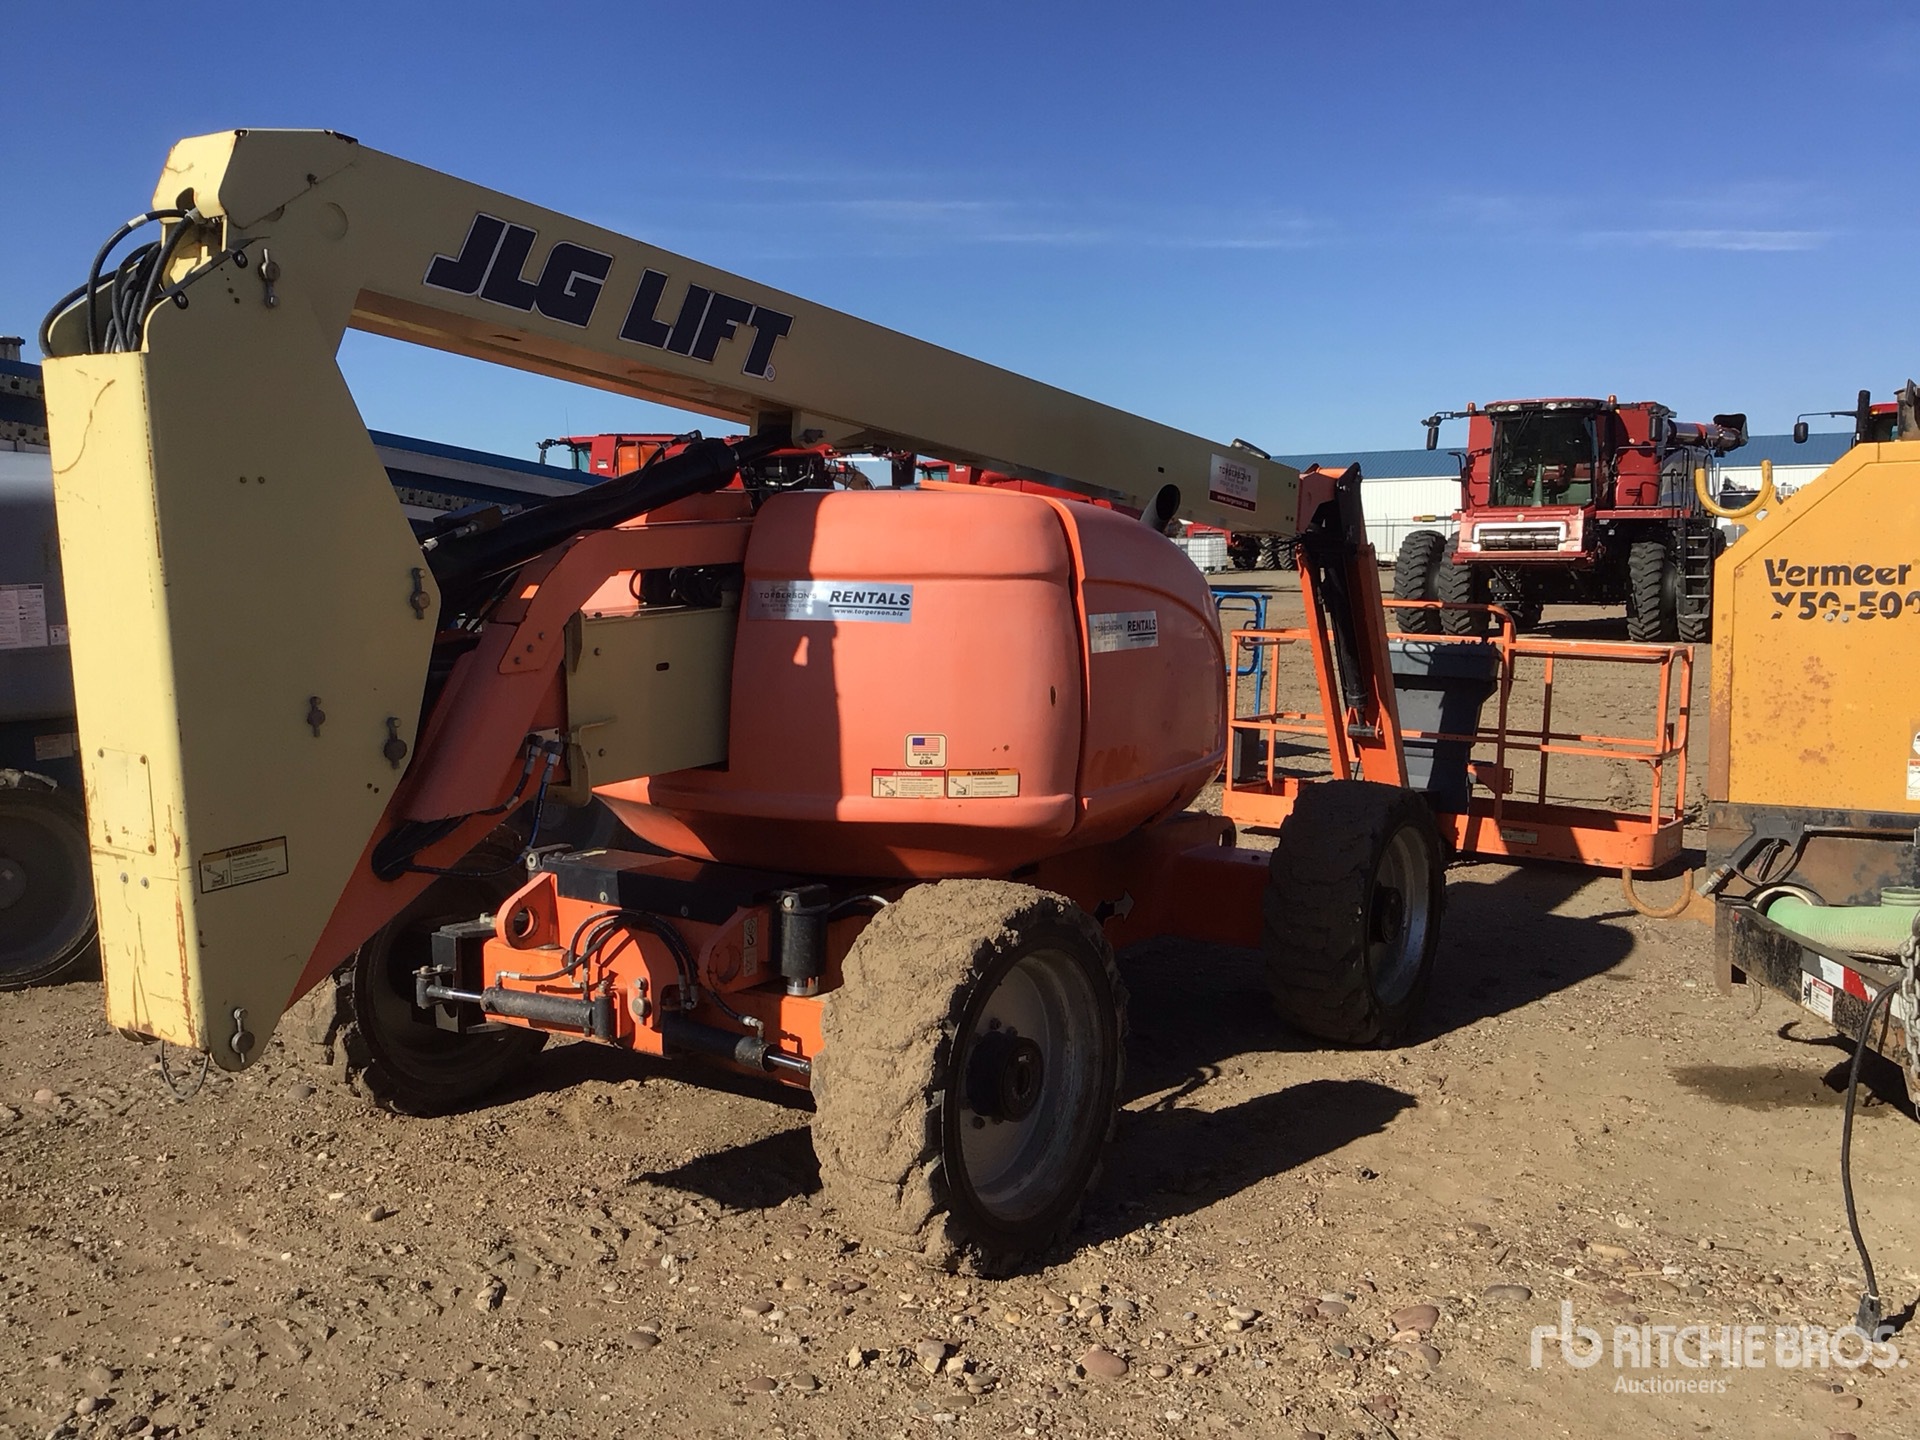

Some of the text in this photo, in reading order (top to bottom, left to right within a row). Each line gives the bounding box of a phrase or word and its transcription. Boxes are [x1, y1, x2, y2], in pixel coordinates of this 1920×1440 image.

[422, 211, 795, 379] JLG LIFT
[1764, 558, 1912, 586] Vermeer
[830, 590, 911, 606] RENTALS
[834, 608, 903, 616] www.torgerson.biz
[1127, 619, 1156, 632] RENTALS
